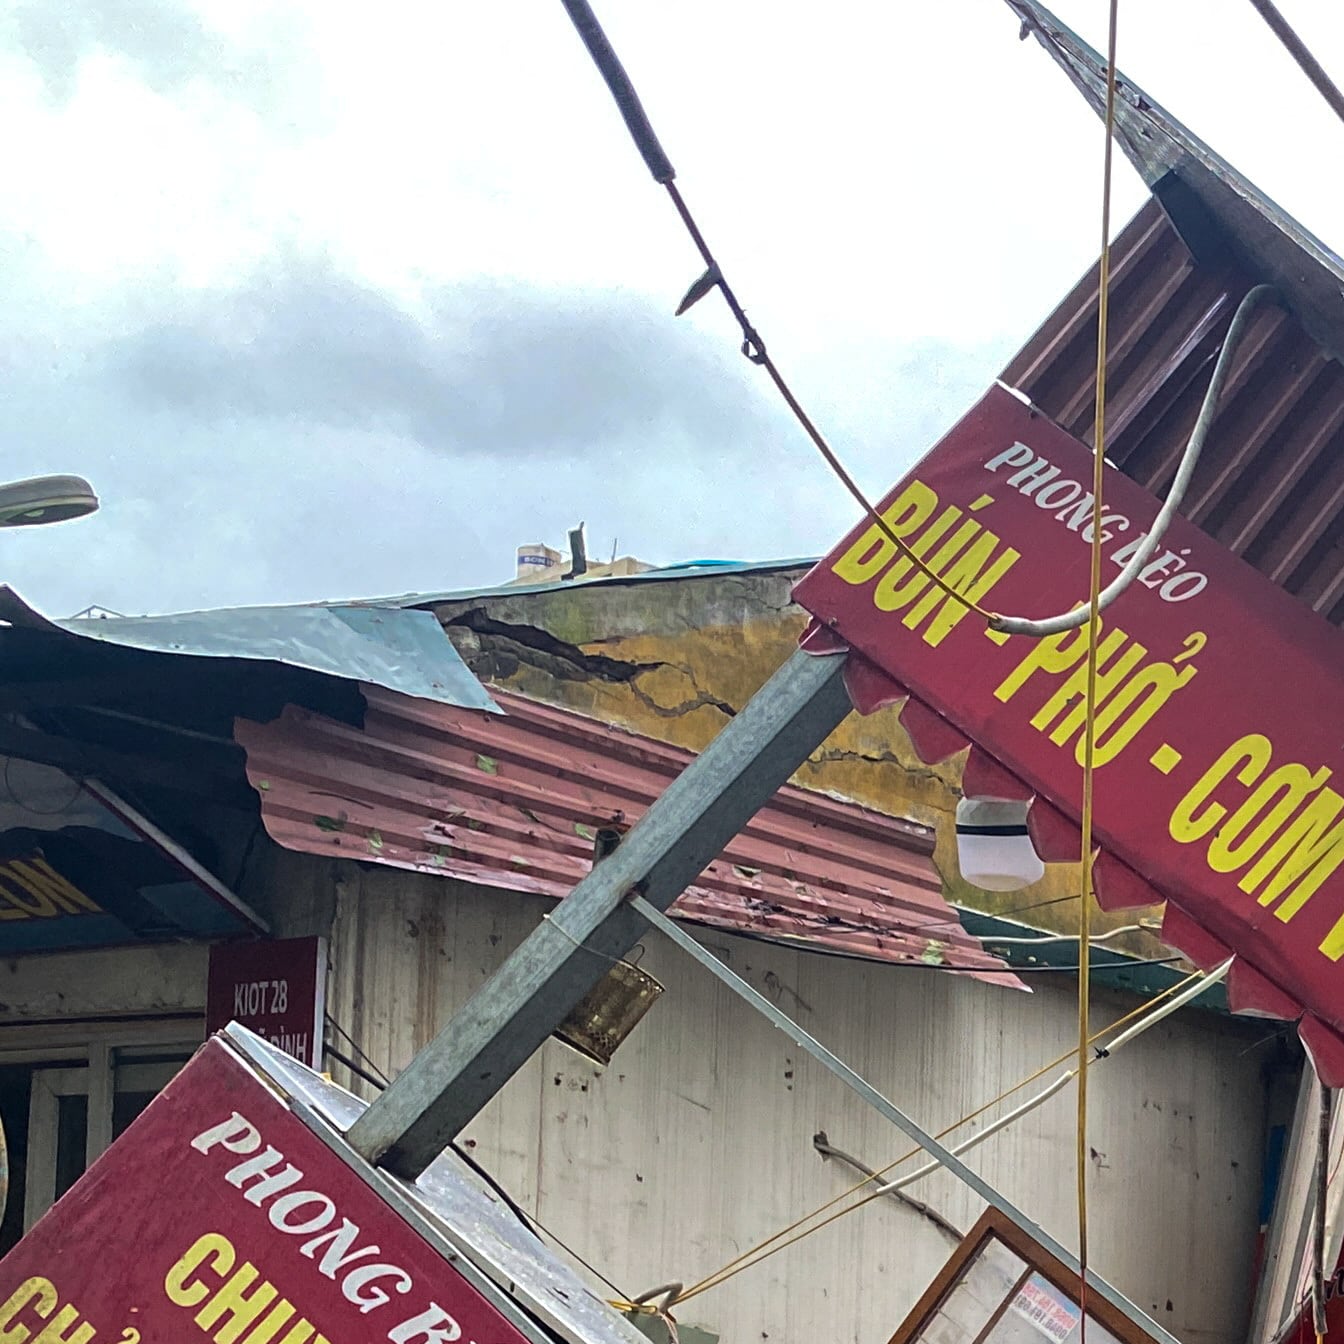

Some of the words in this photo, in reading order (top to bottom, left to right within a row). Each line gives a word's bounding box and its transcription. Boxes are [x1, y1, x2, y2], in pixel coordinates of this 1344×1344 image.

[984, 441, 1130, 545] PHONG
[832, 480, 1021, 648] BÚN
[993, 600, 1207, 768] PHỞ
[233, 981, 269, 1017] KIOT
[270, 979, 288, 1015] 28
[191, 1111, 412, 1316] PHONG
